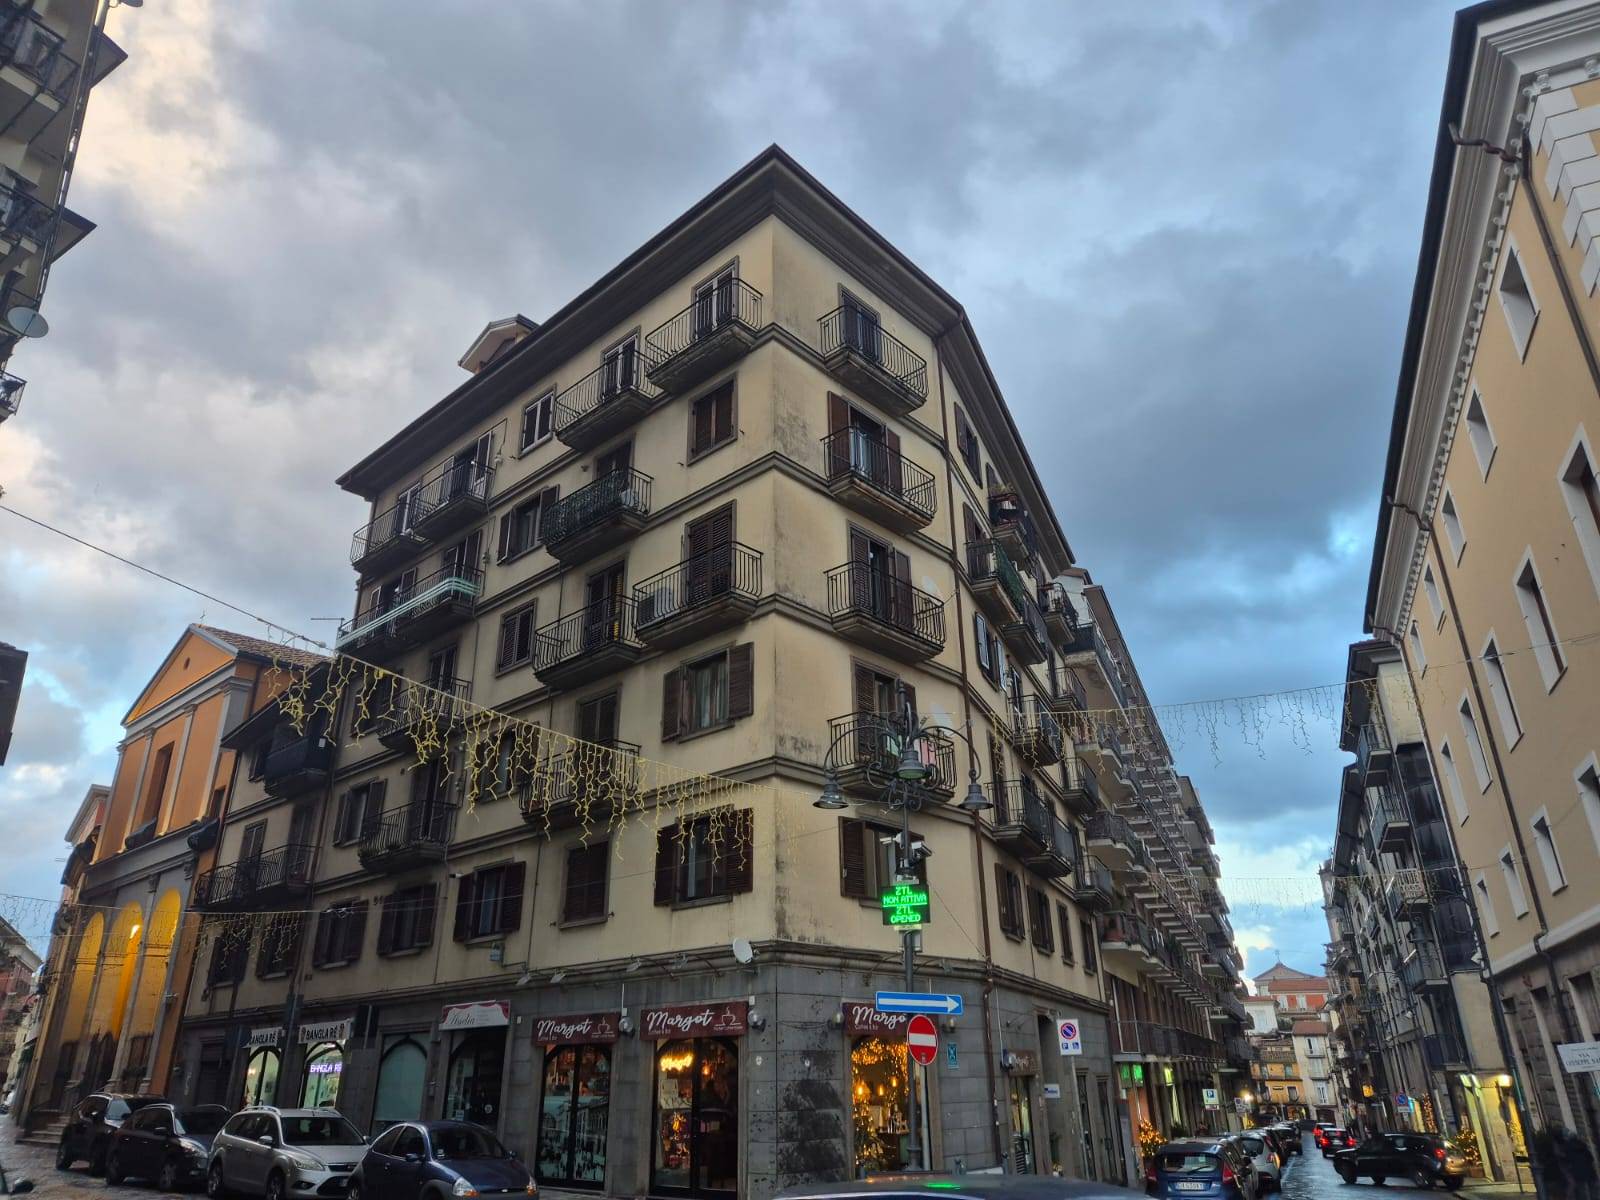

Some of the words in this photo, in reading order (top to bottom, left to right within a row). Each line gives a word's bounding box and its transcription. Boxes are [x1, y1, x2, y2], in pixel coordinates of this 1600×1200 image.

[896, 886, 912, 895] ZTL
[883, 896, 898, 904] NON
[901, 894, 927, 903] ATTIVA
[896, 905, 913, 914] ZTL
[890, 914, 921, 923] OPENED
[647, 1009, 715, 1032] Margot
[852, 1006, 907, 1030] Margo
[306, 1028, 328, 1040] BANGLA
[537, 1018, 592, 1039] Margot
